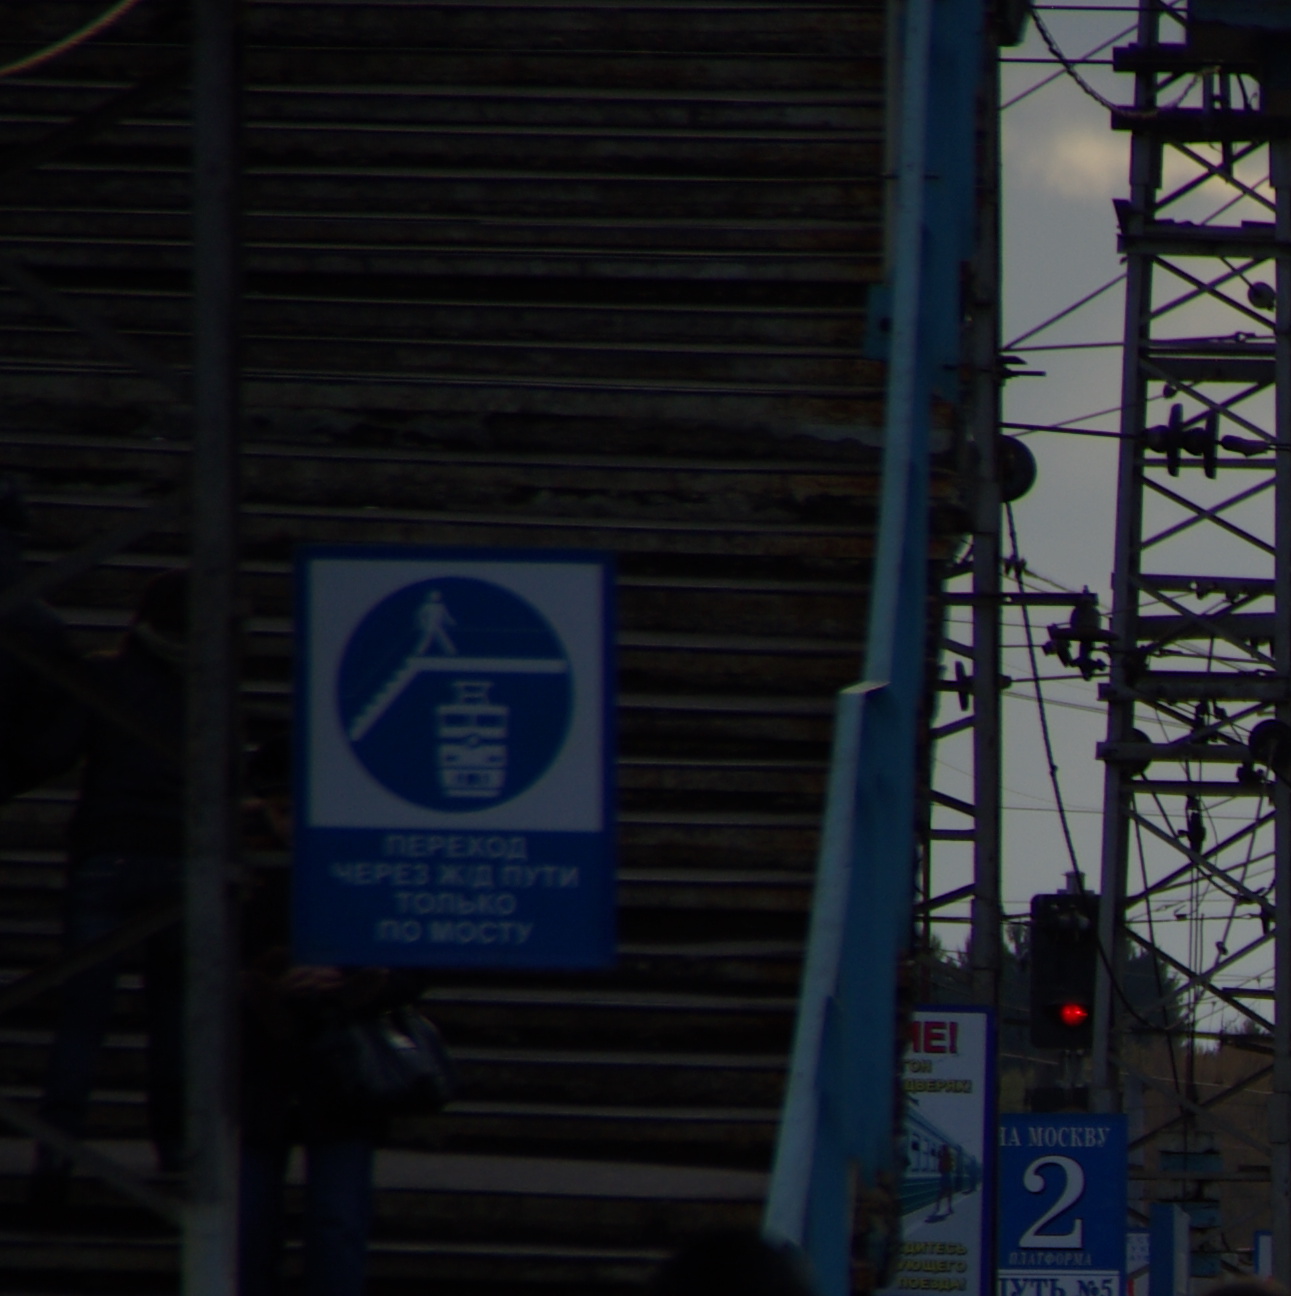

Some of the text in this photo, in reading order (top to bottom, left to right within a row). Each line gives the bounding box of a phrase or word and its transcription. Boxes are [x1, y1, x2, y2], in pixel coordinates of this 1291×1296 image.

[383, 834, 528, 860] ПЕРЕХОД
[330, 862, 582, 888] ЧЕРЕЗ Ж/Д ПУТИ
[394, 891, 518, 915] ТОЛЬКО
[375, 919, 534, 944] ПО МОСТУ
[1028, 1127, 1111, 1147] МОСКВУ
[1018, 1154, 1086, 1250] 2
[1008, 1252, 1092, 1266] ПЛАТФОРМА
